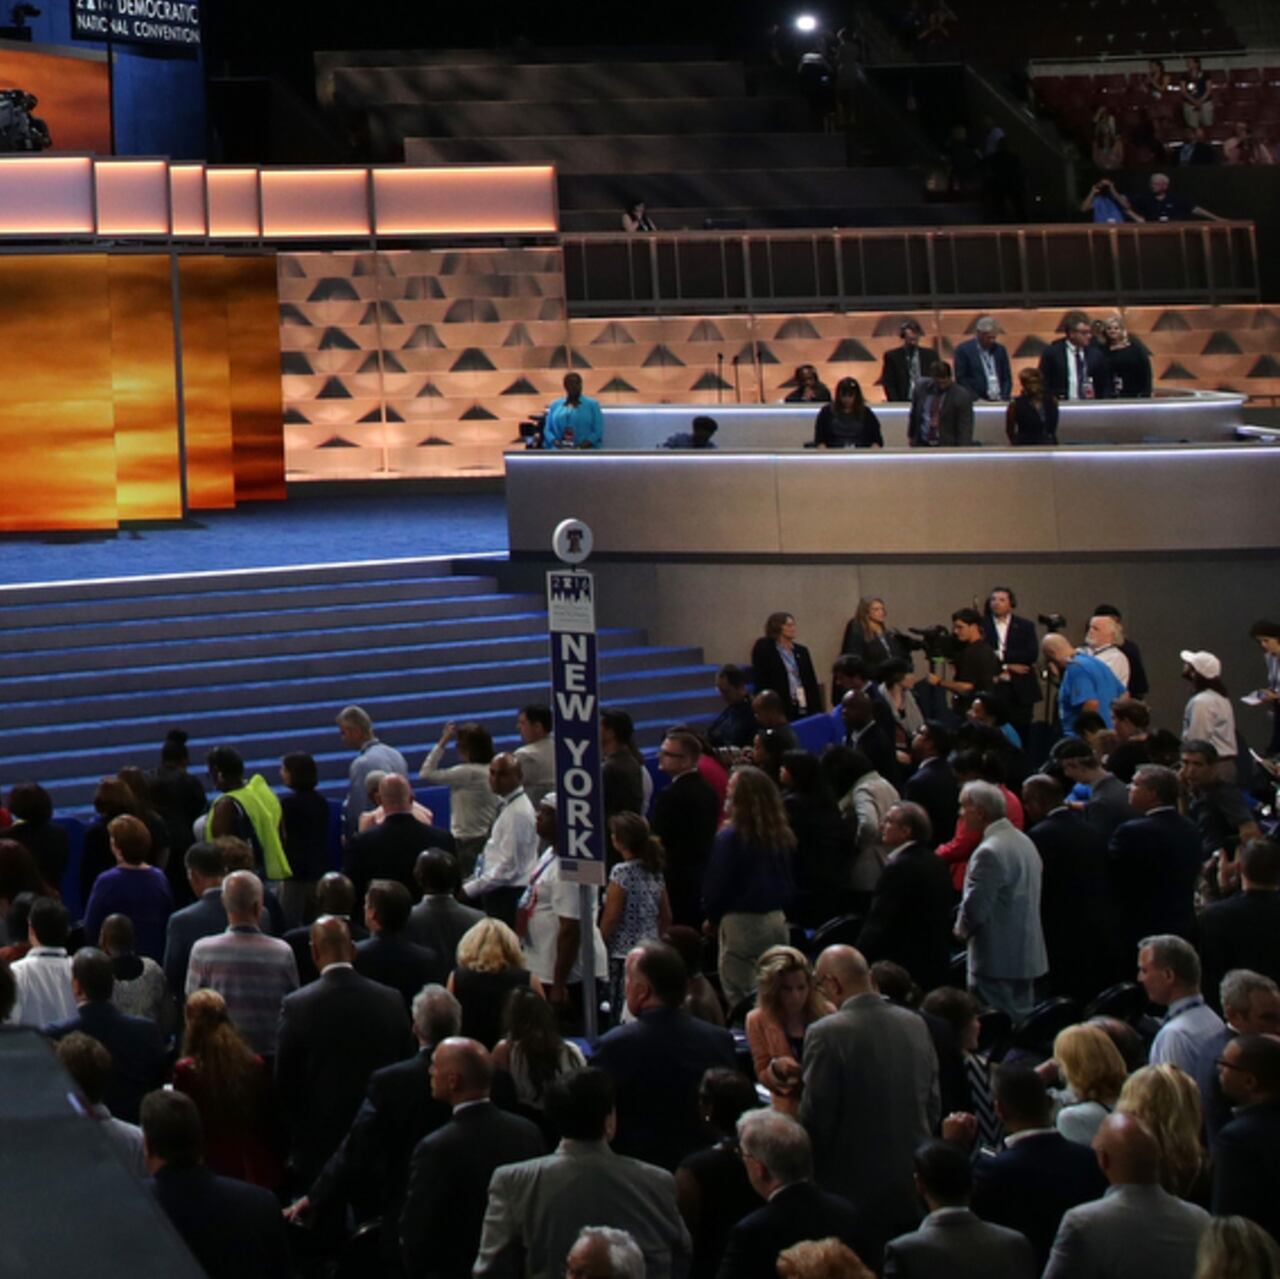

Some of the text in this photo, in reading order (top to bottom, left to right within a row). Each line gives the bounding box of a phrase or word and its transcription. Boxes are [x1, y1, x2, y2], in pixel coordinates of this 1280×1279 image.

[134, 21, 201, 43] CONVENTION
[556, 634, 595, 722] NEW
[563, 738, 594, 859] YORK
